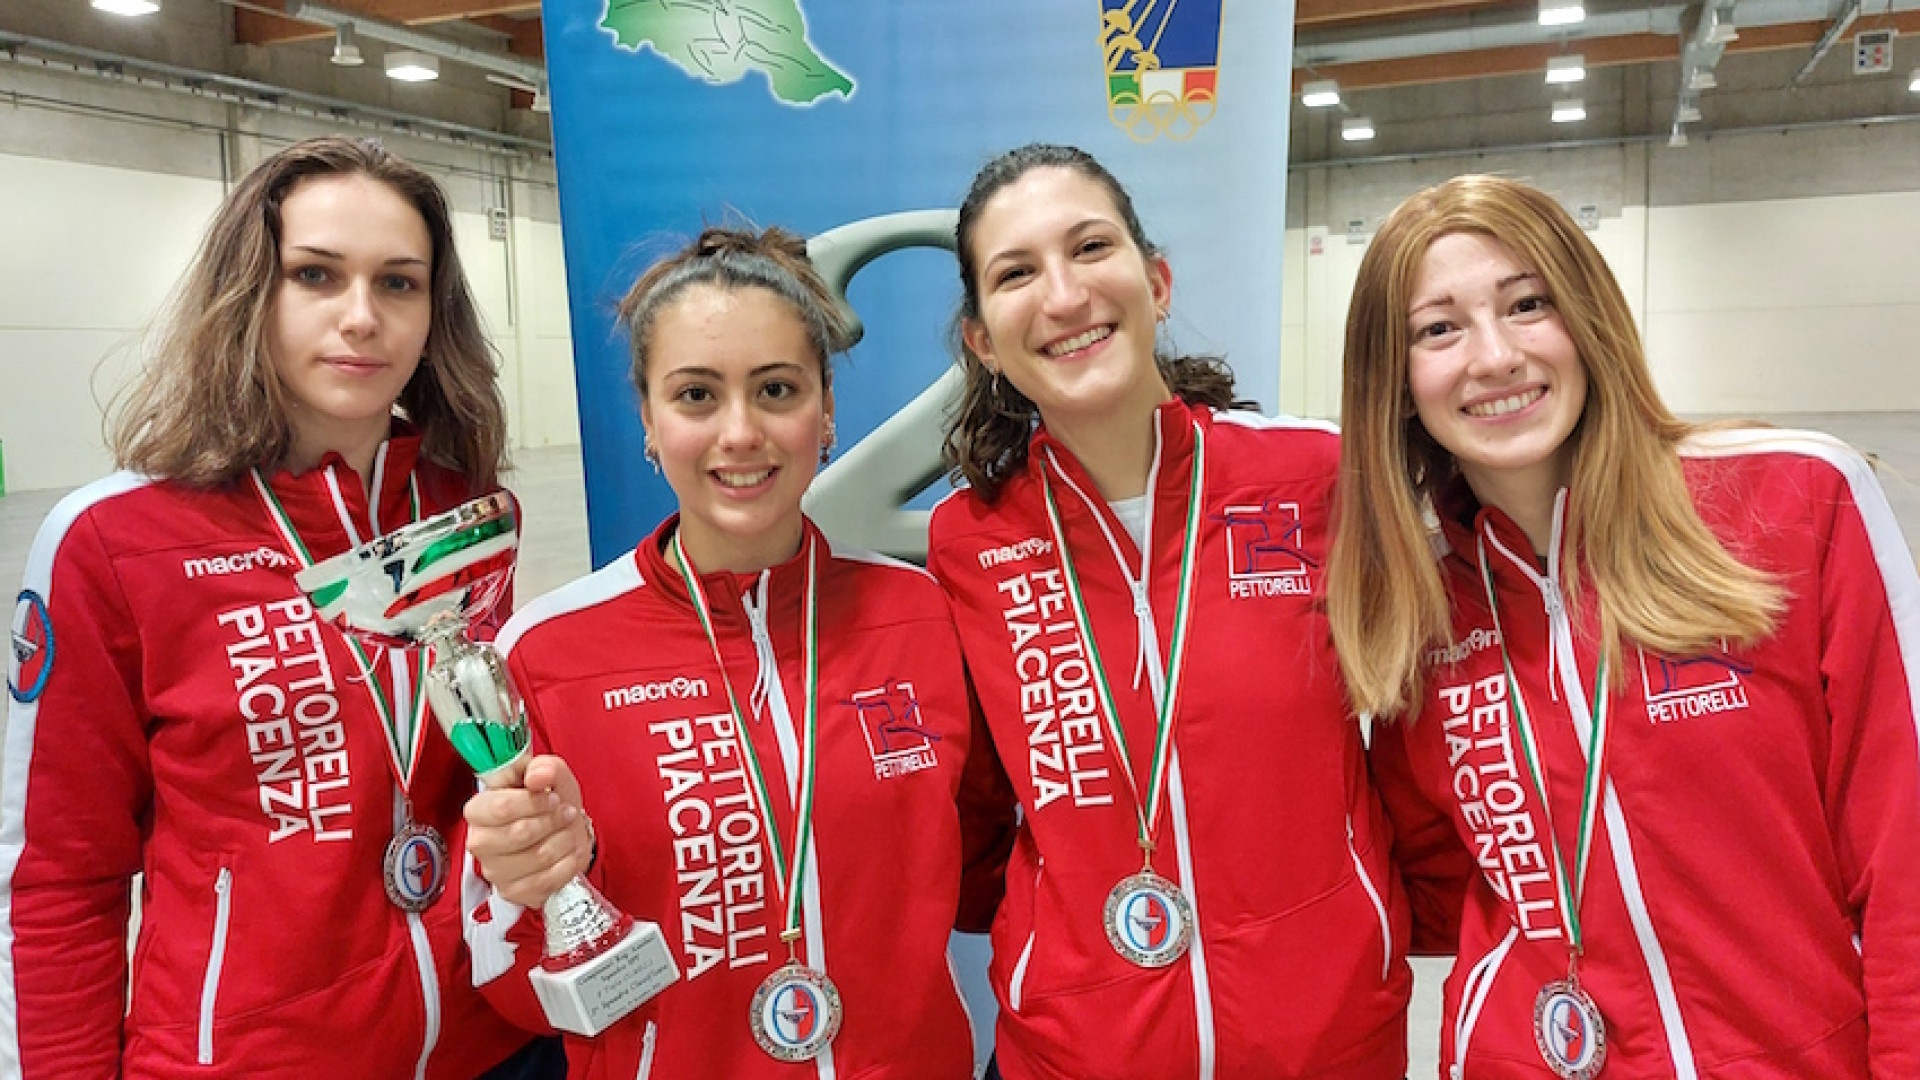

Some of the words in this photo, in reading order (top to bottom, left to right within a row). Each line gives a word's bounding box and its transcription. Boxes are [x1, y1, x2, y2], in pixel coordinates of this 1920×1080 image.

[602, 677, 708, 710] macron
[998, 573, 1069, 812] PIACENZA
[1229, 575, 1311, 600] PETTORELLI
[1646, 686, 1749, 724] PETTORELLI
[216, 605, 309, 844] PIACENZA
[266, 596, 353, 843] PETTORELLI
[1472, 674, 1563, 940] PETTORELLI
[648, 717, 726, 981] PIACENZA
[695, 713, 769, 969] PETTORELLI
